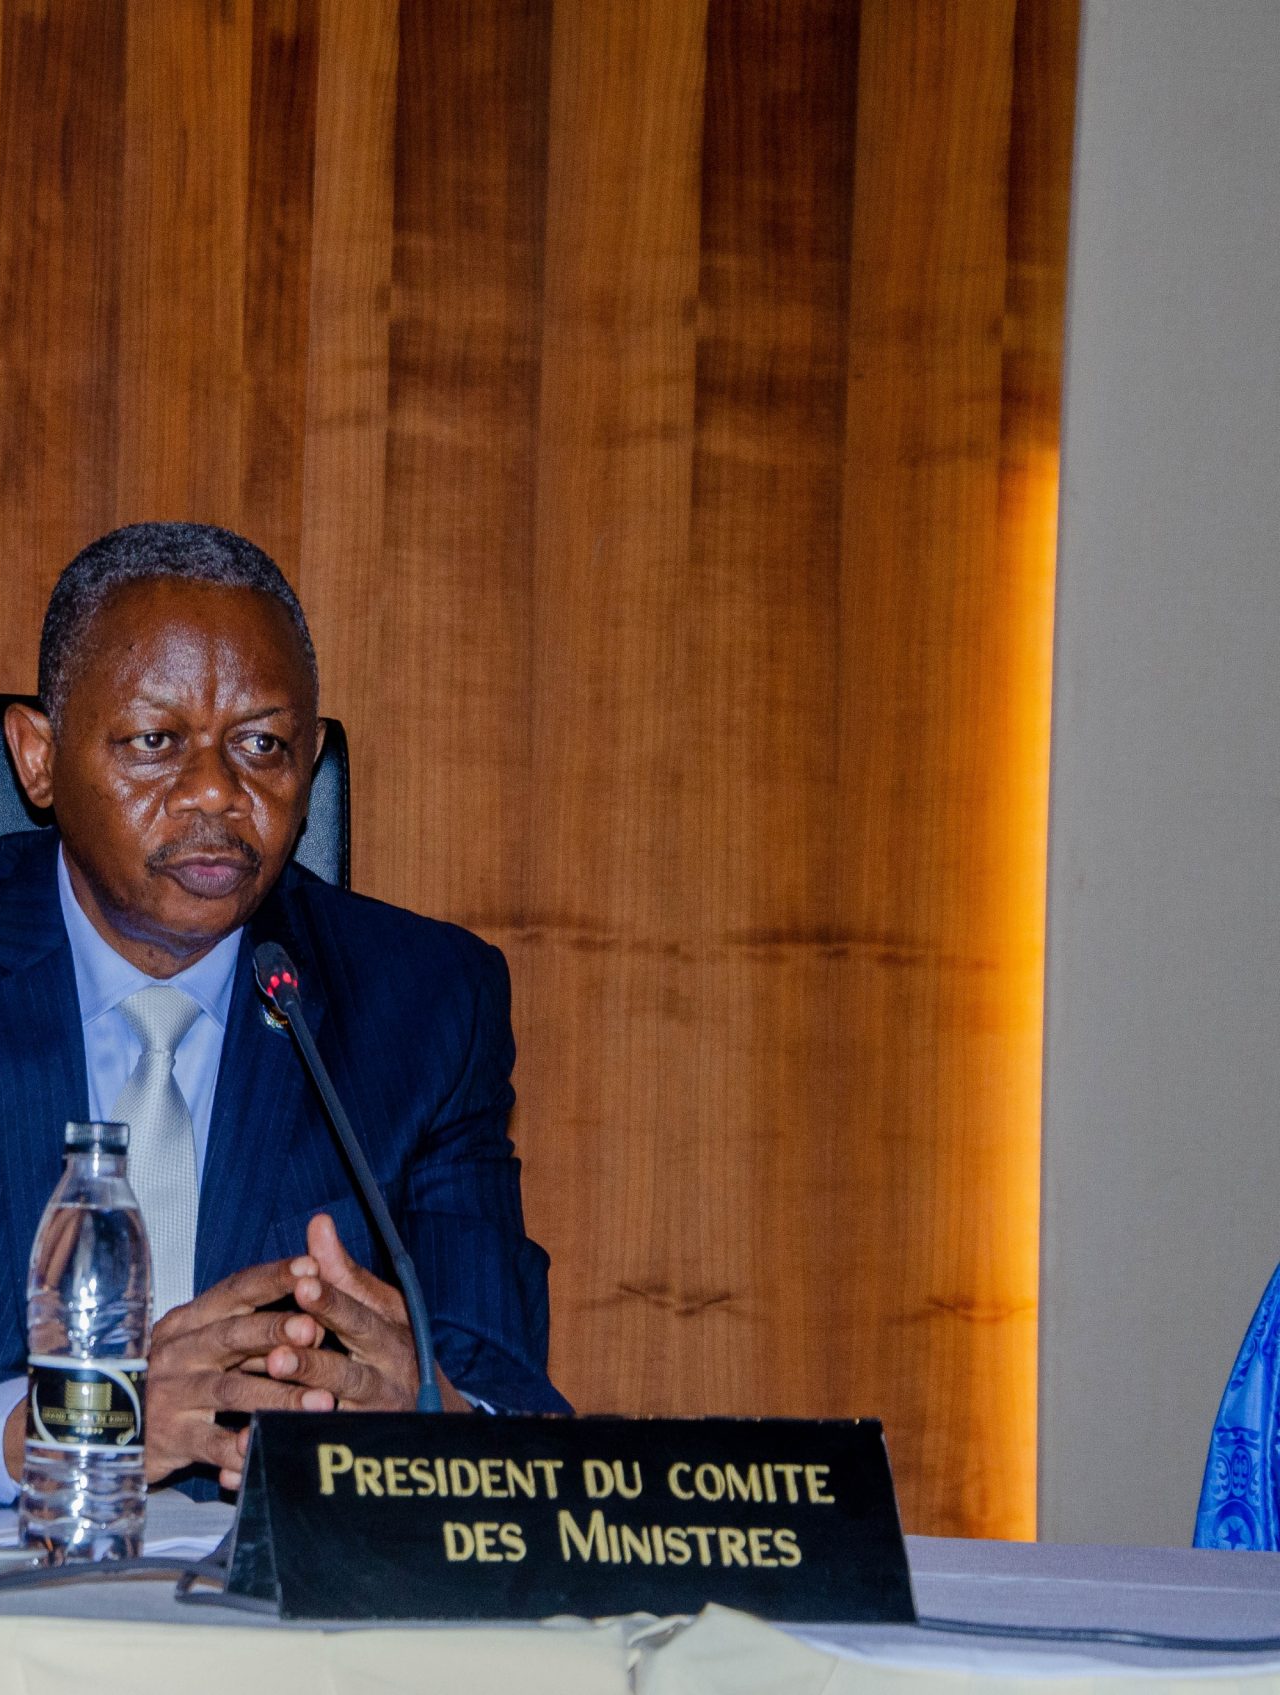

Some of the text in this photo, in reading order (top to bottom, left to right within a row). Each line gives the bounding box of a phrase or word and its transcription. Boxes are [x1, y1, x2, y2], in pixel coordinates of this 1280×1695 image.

[318, 1444, 835, 1503] PRESIDENT DU COMITE
[442, 1510, 802, 1567] DES MINISTRES
